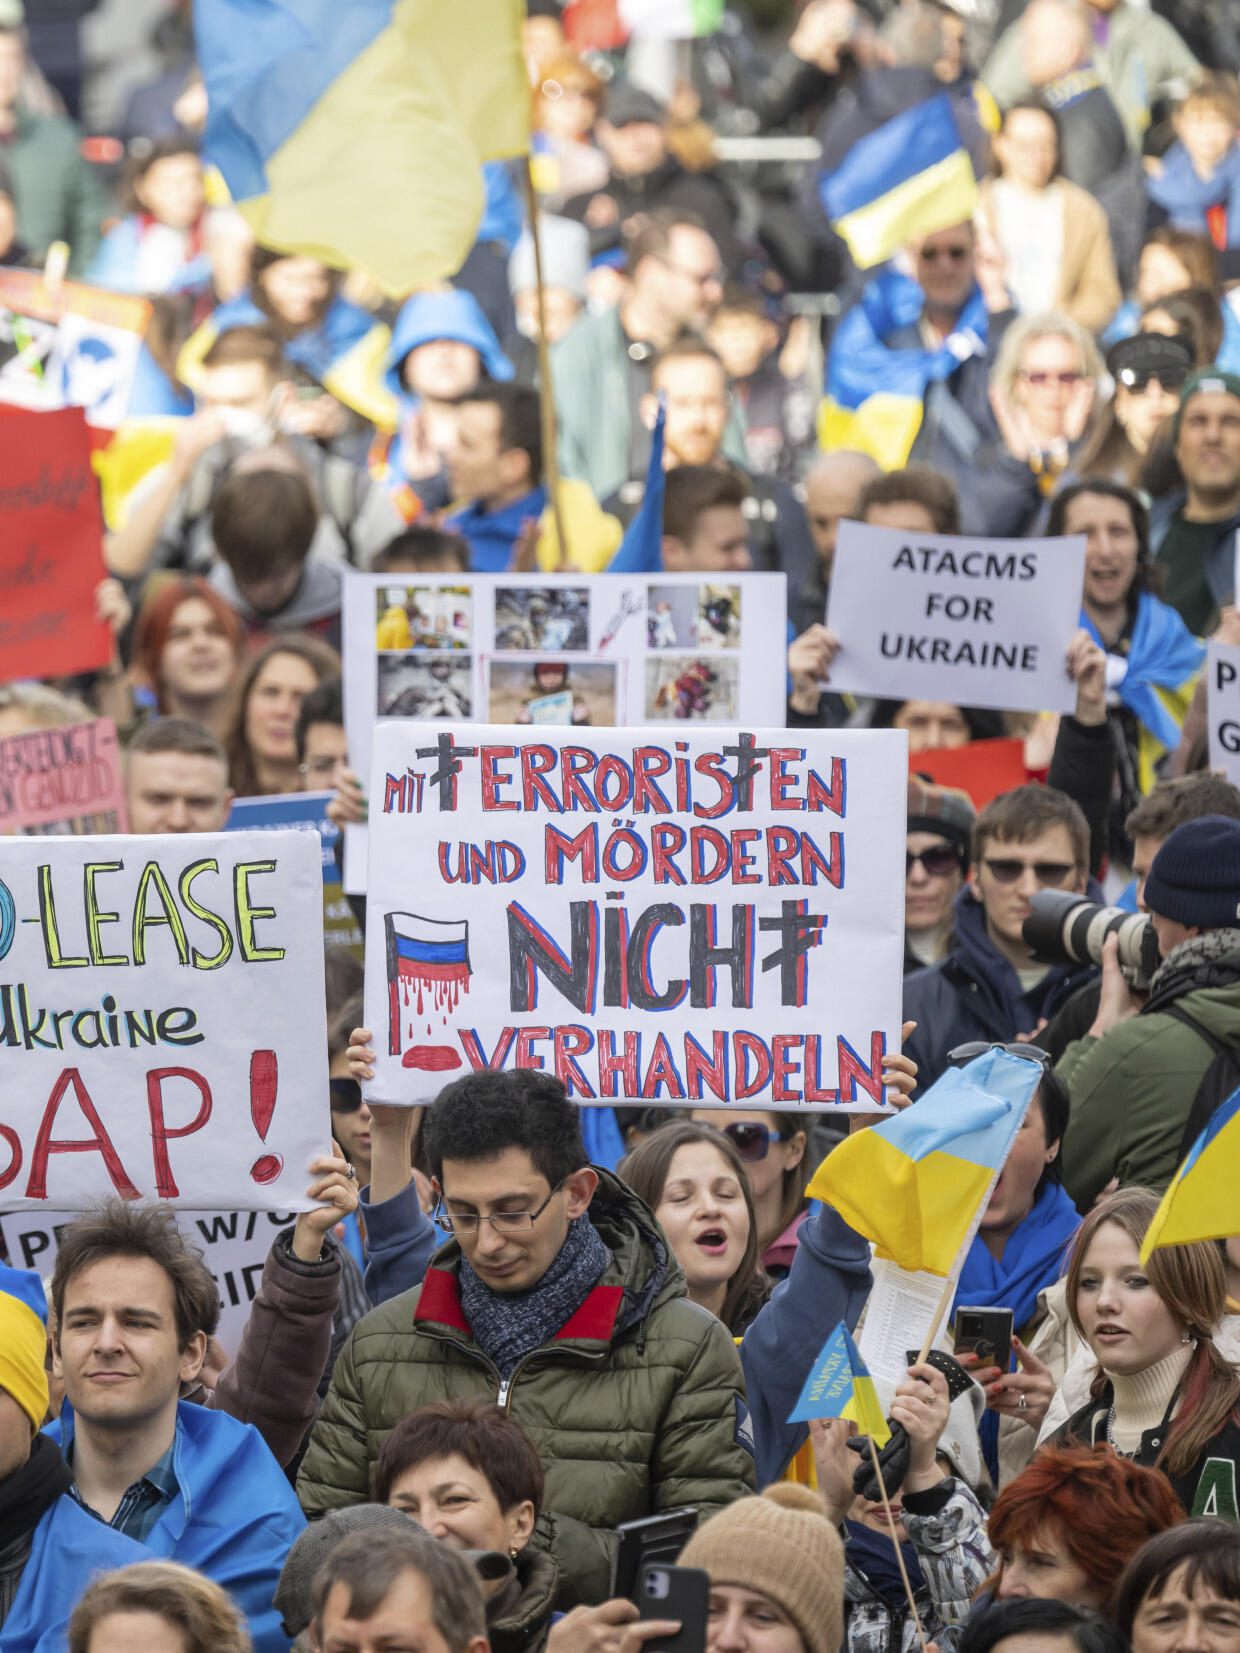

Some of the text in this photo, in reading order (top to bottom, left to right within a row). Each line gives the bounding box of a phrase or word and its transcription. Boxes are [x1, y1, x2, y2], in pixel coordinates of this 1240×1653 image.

[892, 545, 1038, 581] ATACMS
[925, 593, 994, 624] FOR
[880, 632, 1039, 672] UKRAINE
[383, 767, 426, 813] MIT
[438, 818, 845, 889] UND MÖRDERN
[506, 891, 828, 1015] NICHT
[457, 1024, 887, 1106] VERHANDELN
